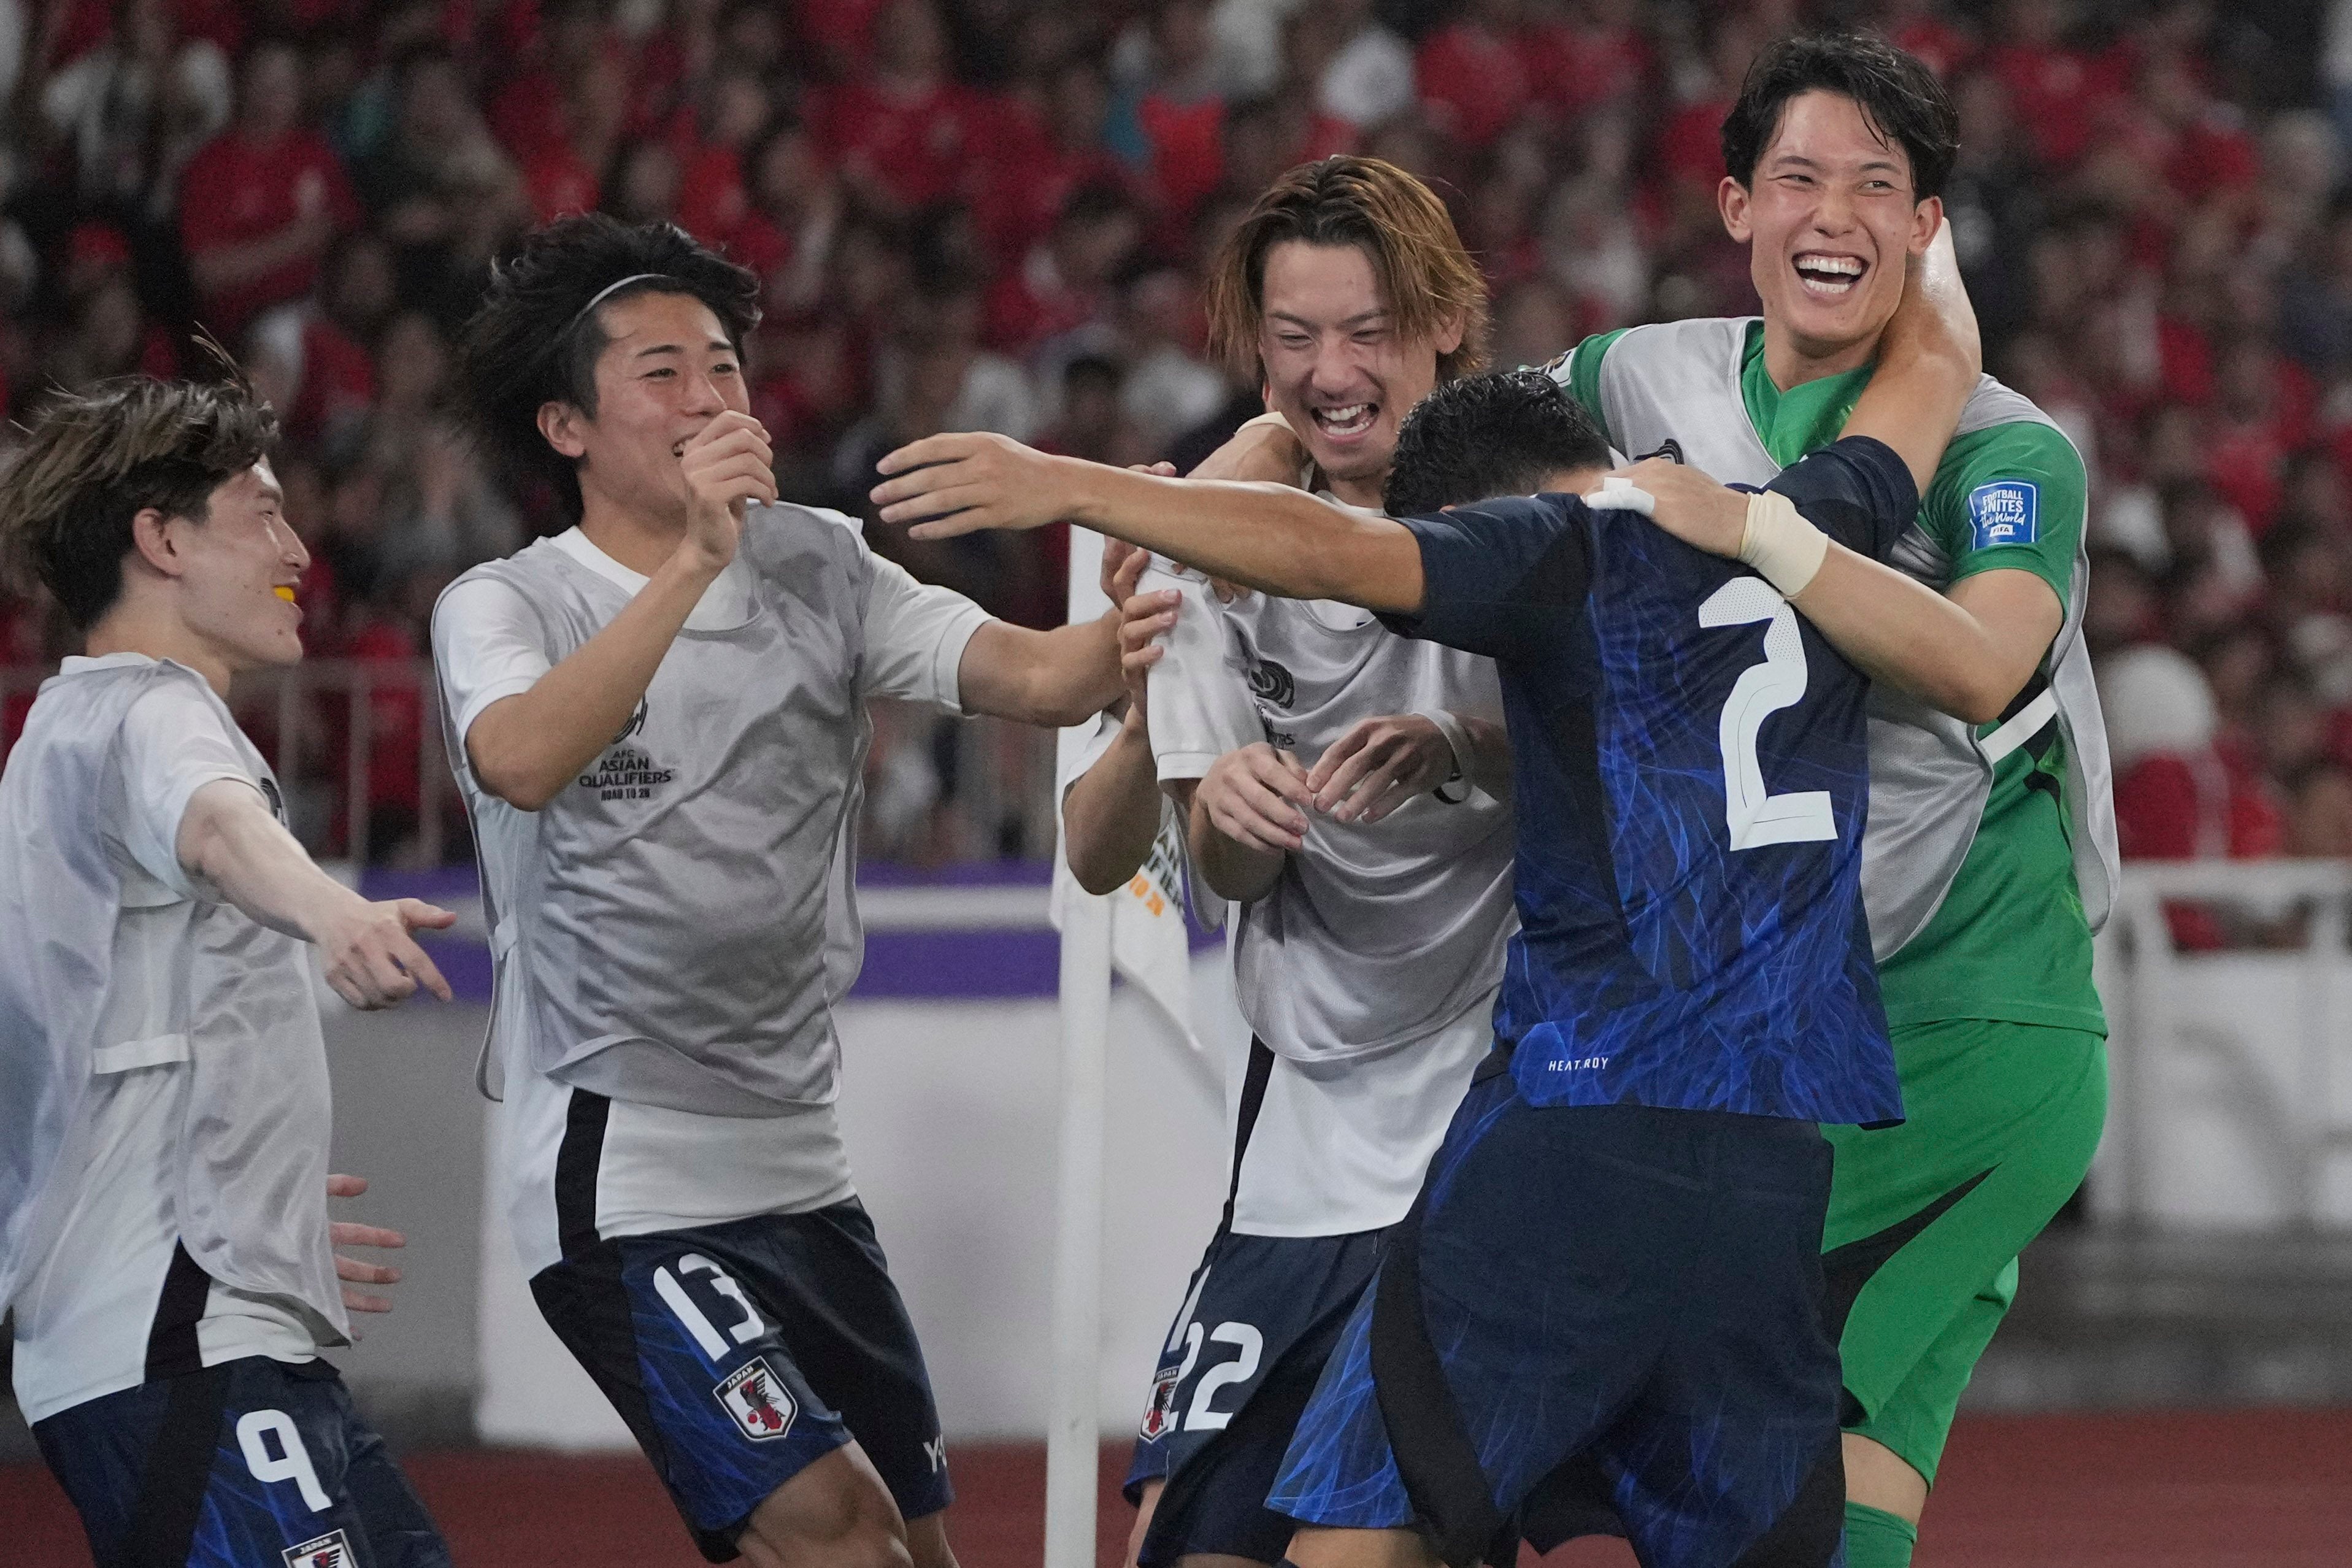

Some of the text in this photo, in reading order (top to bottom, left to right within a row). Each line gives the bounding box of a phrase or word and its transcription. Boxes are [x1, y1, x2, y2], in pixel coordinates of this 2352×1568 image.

[1982, 490, 2024, 506] FOOTBALL
[1980, 513, 1994, 528] the
[1995, 512, 2026, 526] World
[1698, 576, 1839, 851] 2
[612, 749, 635, 758] AFC
[599, 756, 649, 772] ASIAN
[579, 770, 672, 788] QUALIFIERS
[653, 1253, 765, 1362] 13
[727, 1365, 754, 1389] JAPAN
[236, 1409, 333, 1513] 9
[300, 1537, 332, 1555] JAPAN
